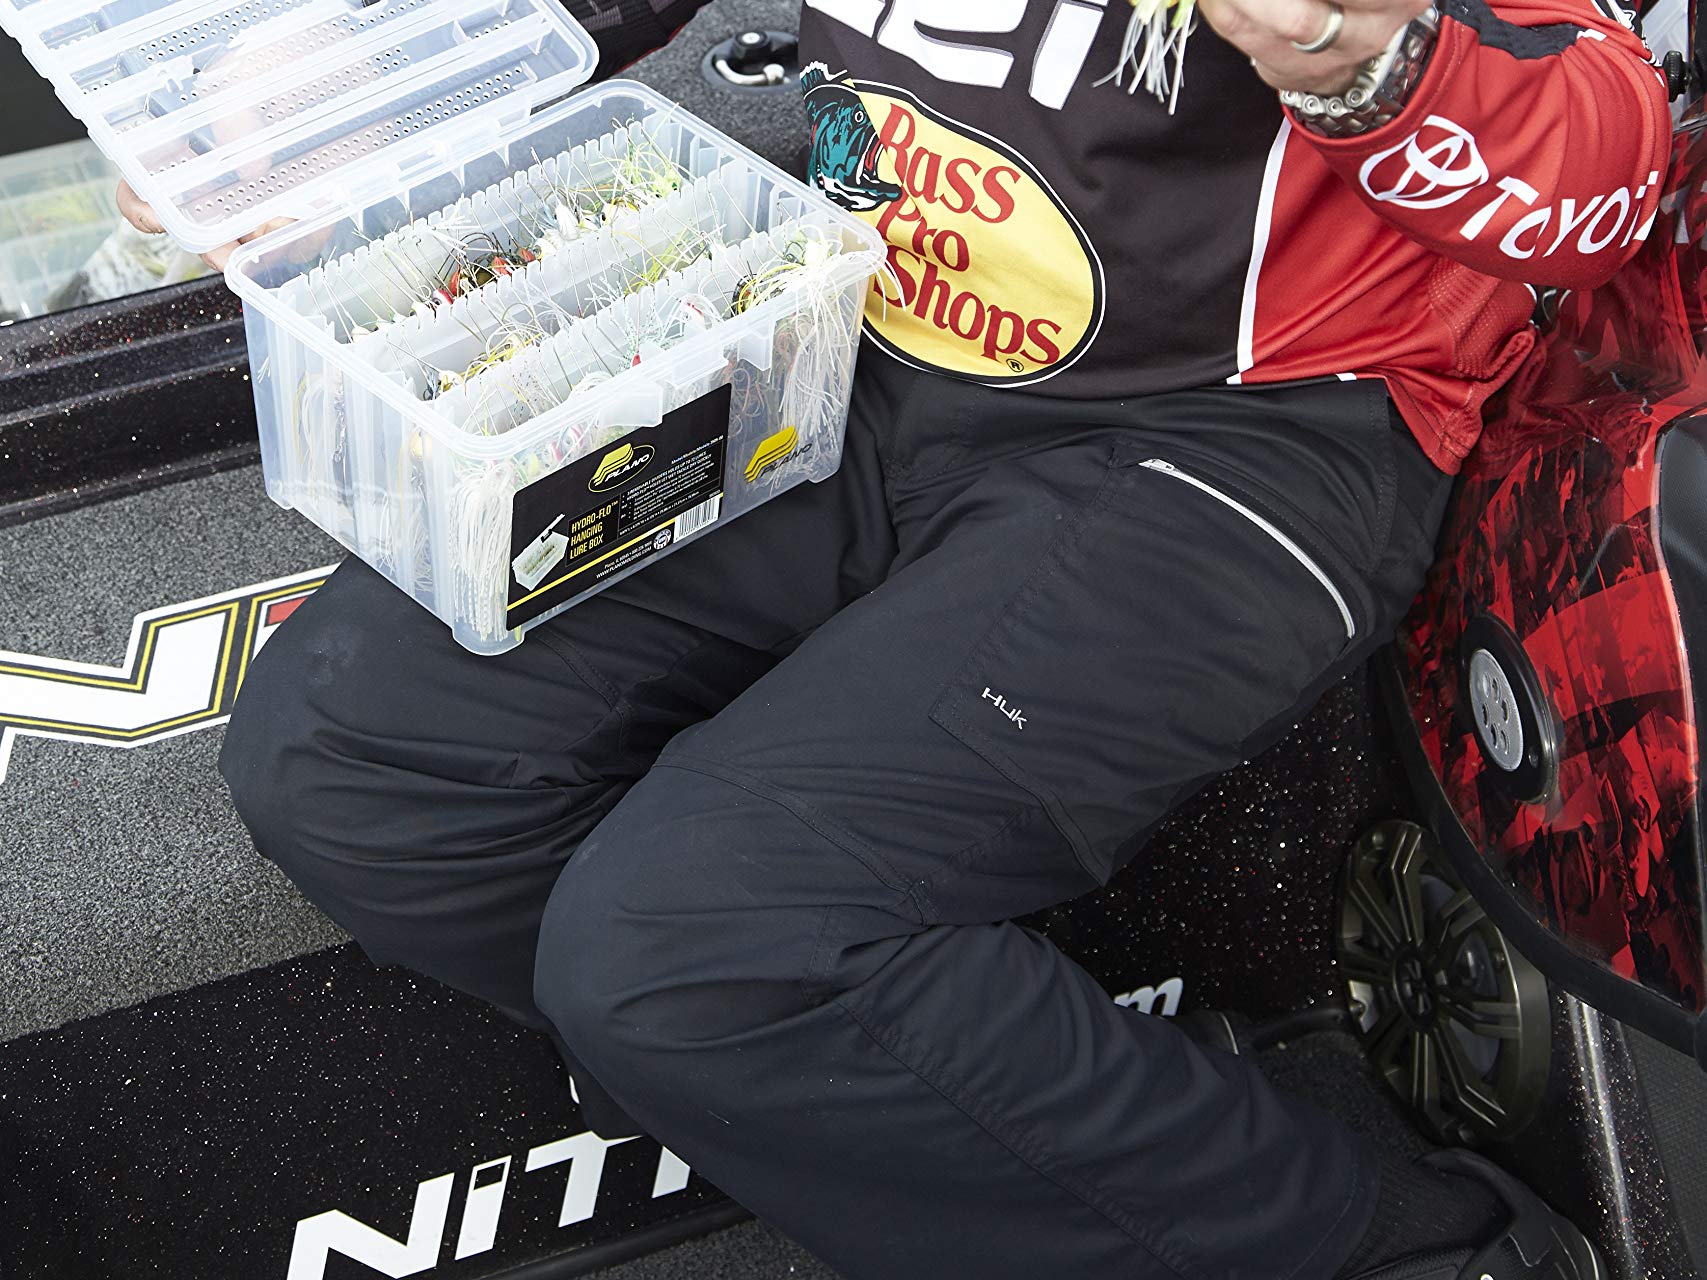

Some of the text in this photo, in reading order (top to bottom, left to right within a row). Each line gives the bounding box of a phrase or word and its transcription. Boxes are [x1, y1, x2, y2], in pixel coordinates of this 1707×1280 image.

[878, 101, 1022, 224] Bass
[873, 186, 971, 273] Pro
[873, 244, 1063, 366] Shops
[604, 453, 651, 483] PLANO
[759, 442, 813, 478] PLANO
[569, 542, 588, 560] LURE
[588, 534, 604, 551] BOX
[570, 521, 603, 546] HANGING
